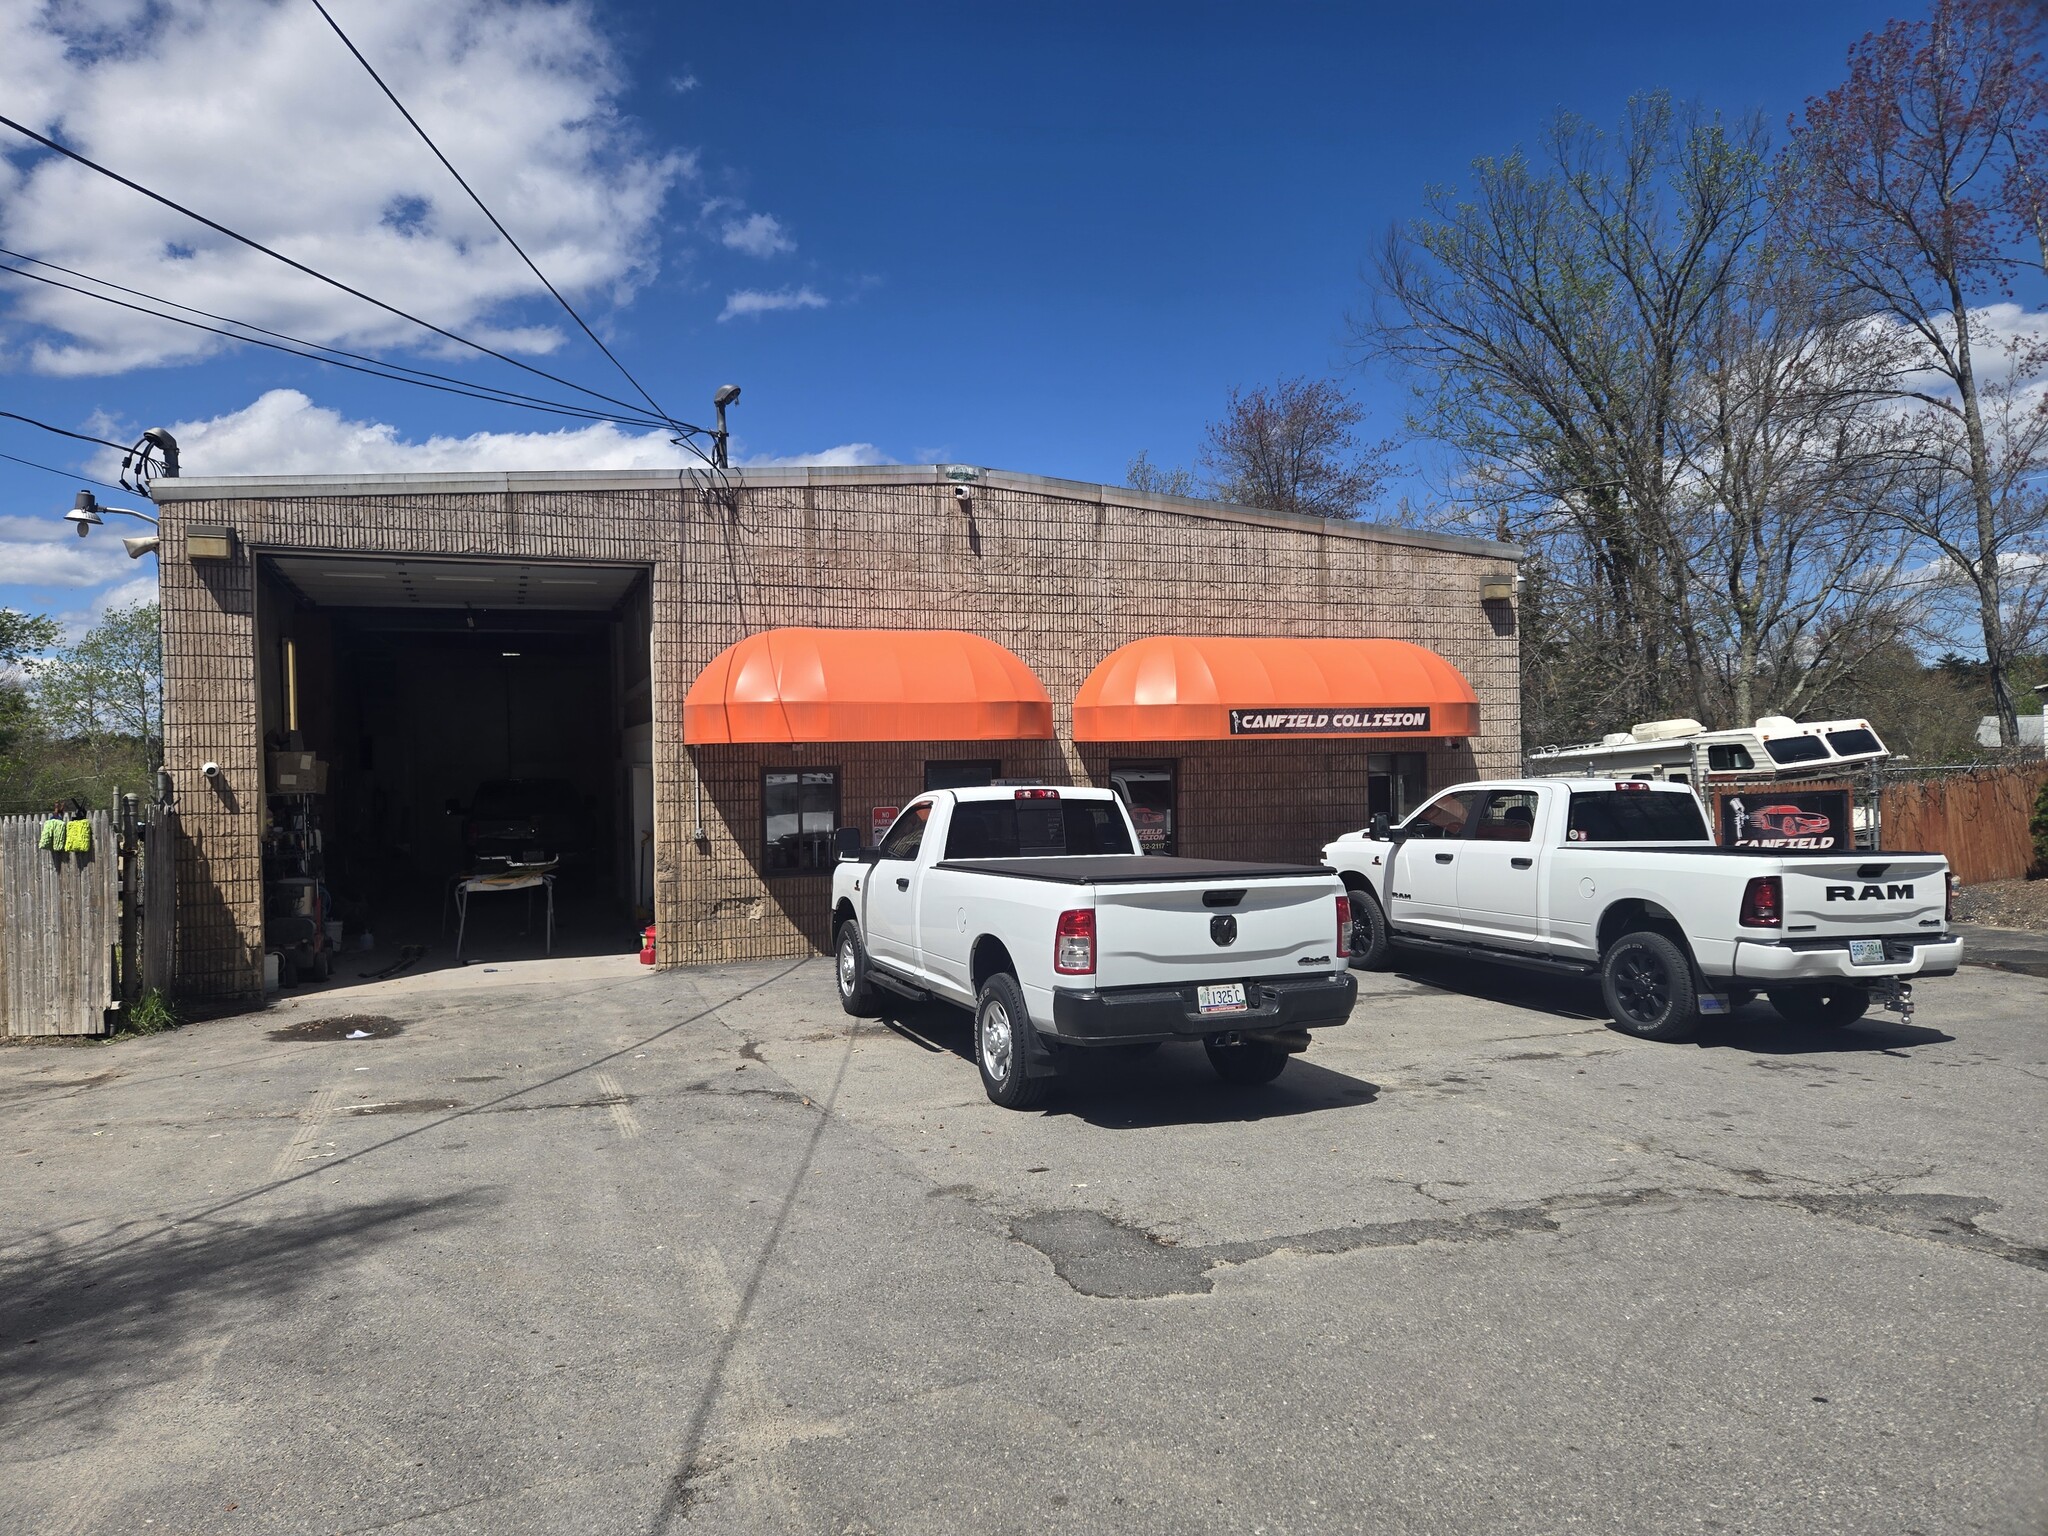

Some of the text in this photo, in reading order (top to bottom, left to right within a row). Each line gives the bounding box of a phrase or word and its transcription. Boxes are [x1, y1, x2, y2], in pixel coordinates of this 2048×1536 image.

[1241, 712, 1426, 729] CANFIELD COLLISION
[874, 818, 894, 826] PARKIN
[1391, 891, 1411, 899] RAM
[1825, 883, 1914, 901] RAM
